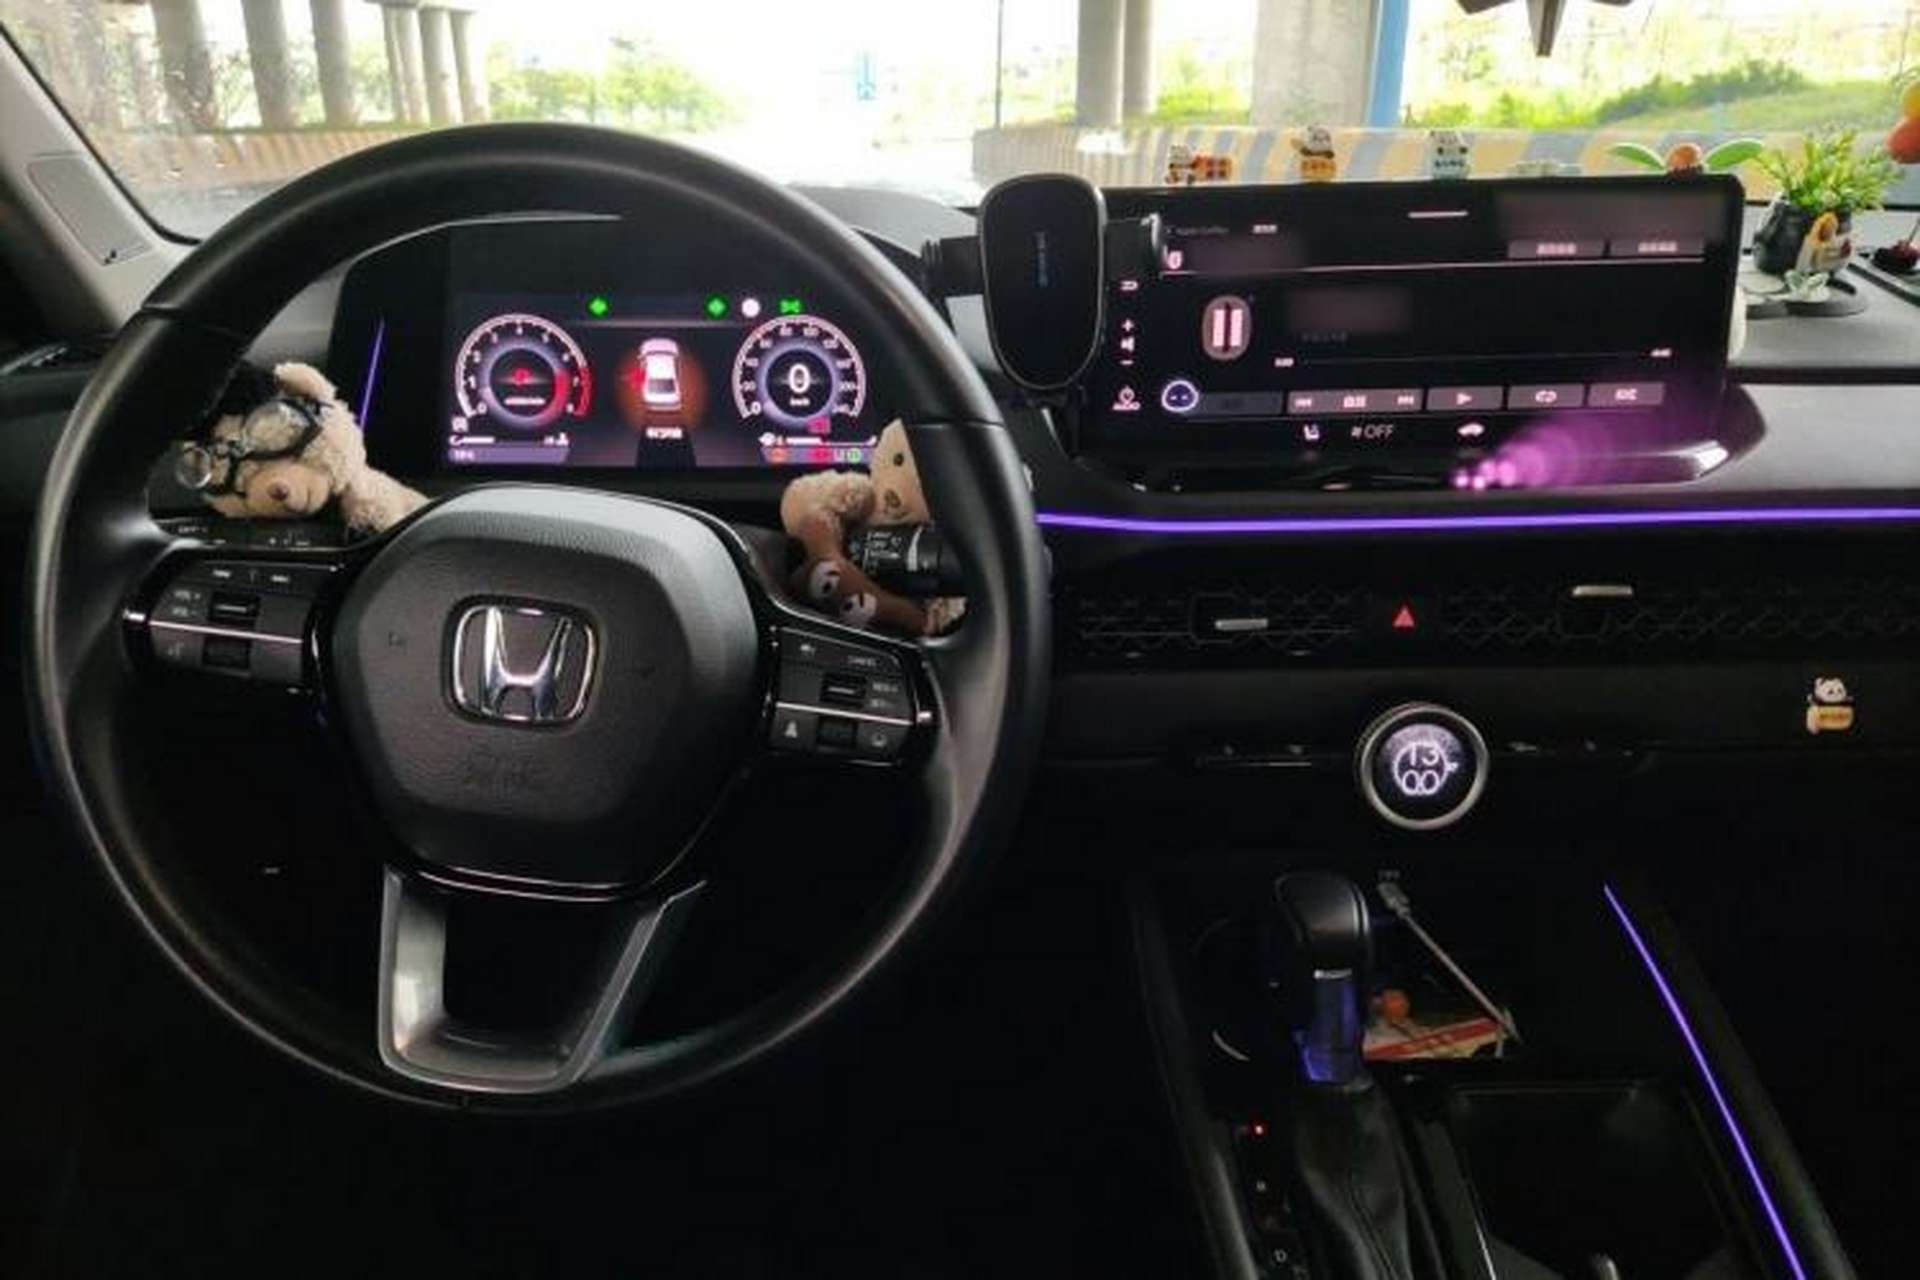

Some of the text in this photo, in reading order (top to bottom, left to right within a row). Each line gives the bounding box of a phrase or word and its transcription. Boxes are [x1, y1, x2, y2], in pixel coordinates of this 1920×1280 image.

[788, 363, 811, 394] 0
[1363, 423, 1394, 439] OFF
[1408, 740, 1441, 767] 13
[1401, 769, 1441, 796] 00
